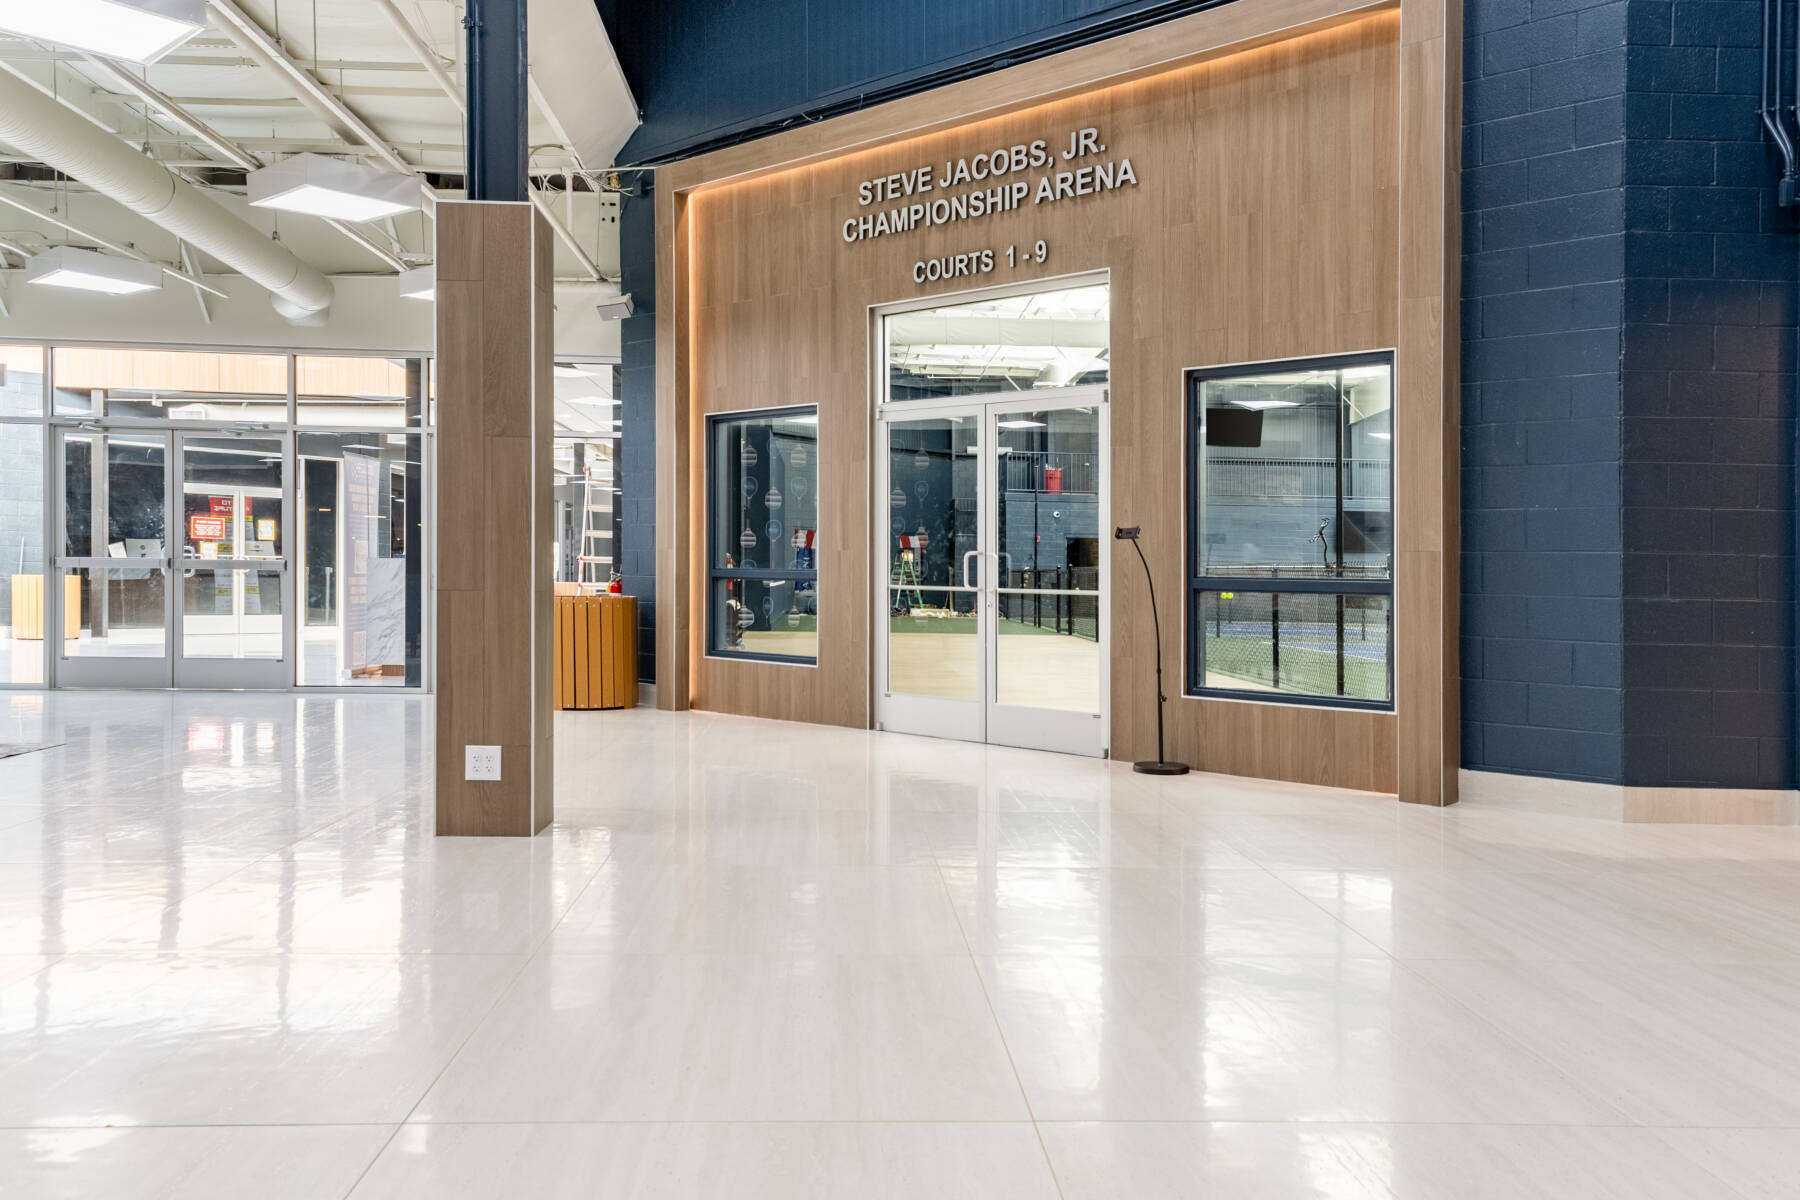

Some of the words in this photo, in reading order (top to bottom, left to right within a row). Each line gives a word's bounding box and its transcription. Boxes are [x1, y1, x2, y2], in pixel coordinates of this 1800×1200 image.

[843, 182, 1029, 243] CHAMPIONSHIP
[1035, 158, 1138, 204] ARENA
[858, 166, 932, 206] STEVE
[939, 140, 1054, 188] JACOBS,
[1062, 127, 1106, 160] JR.
[913, 249, 994, 283] COURTS
